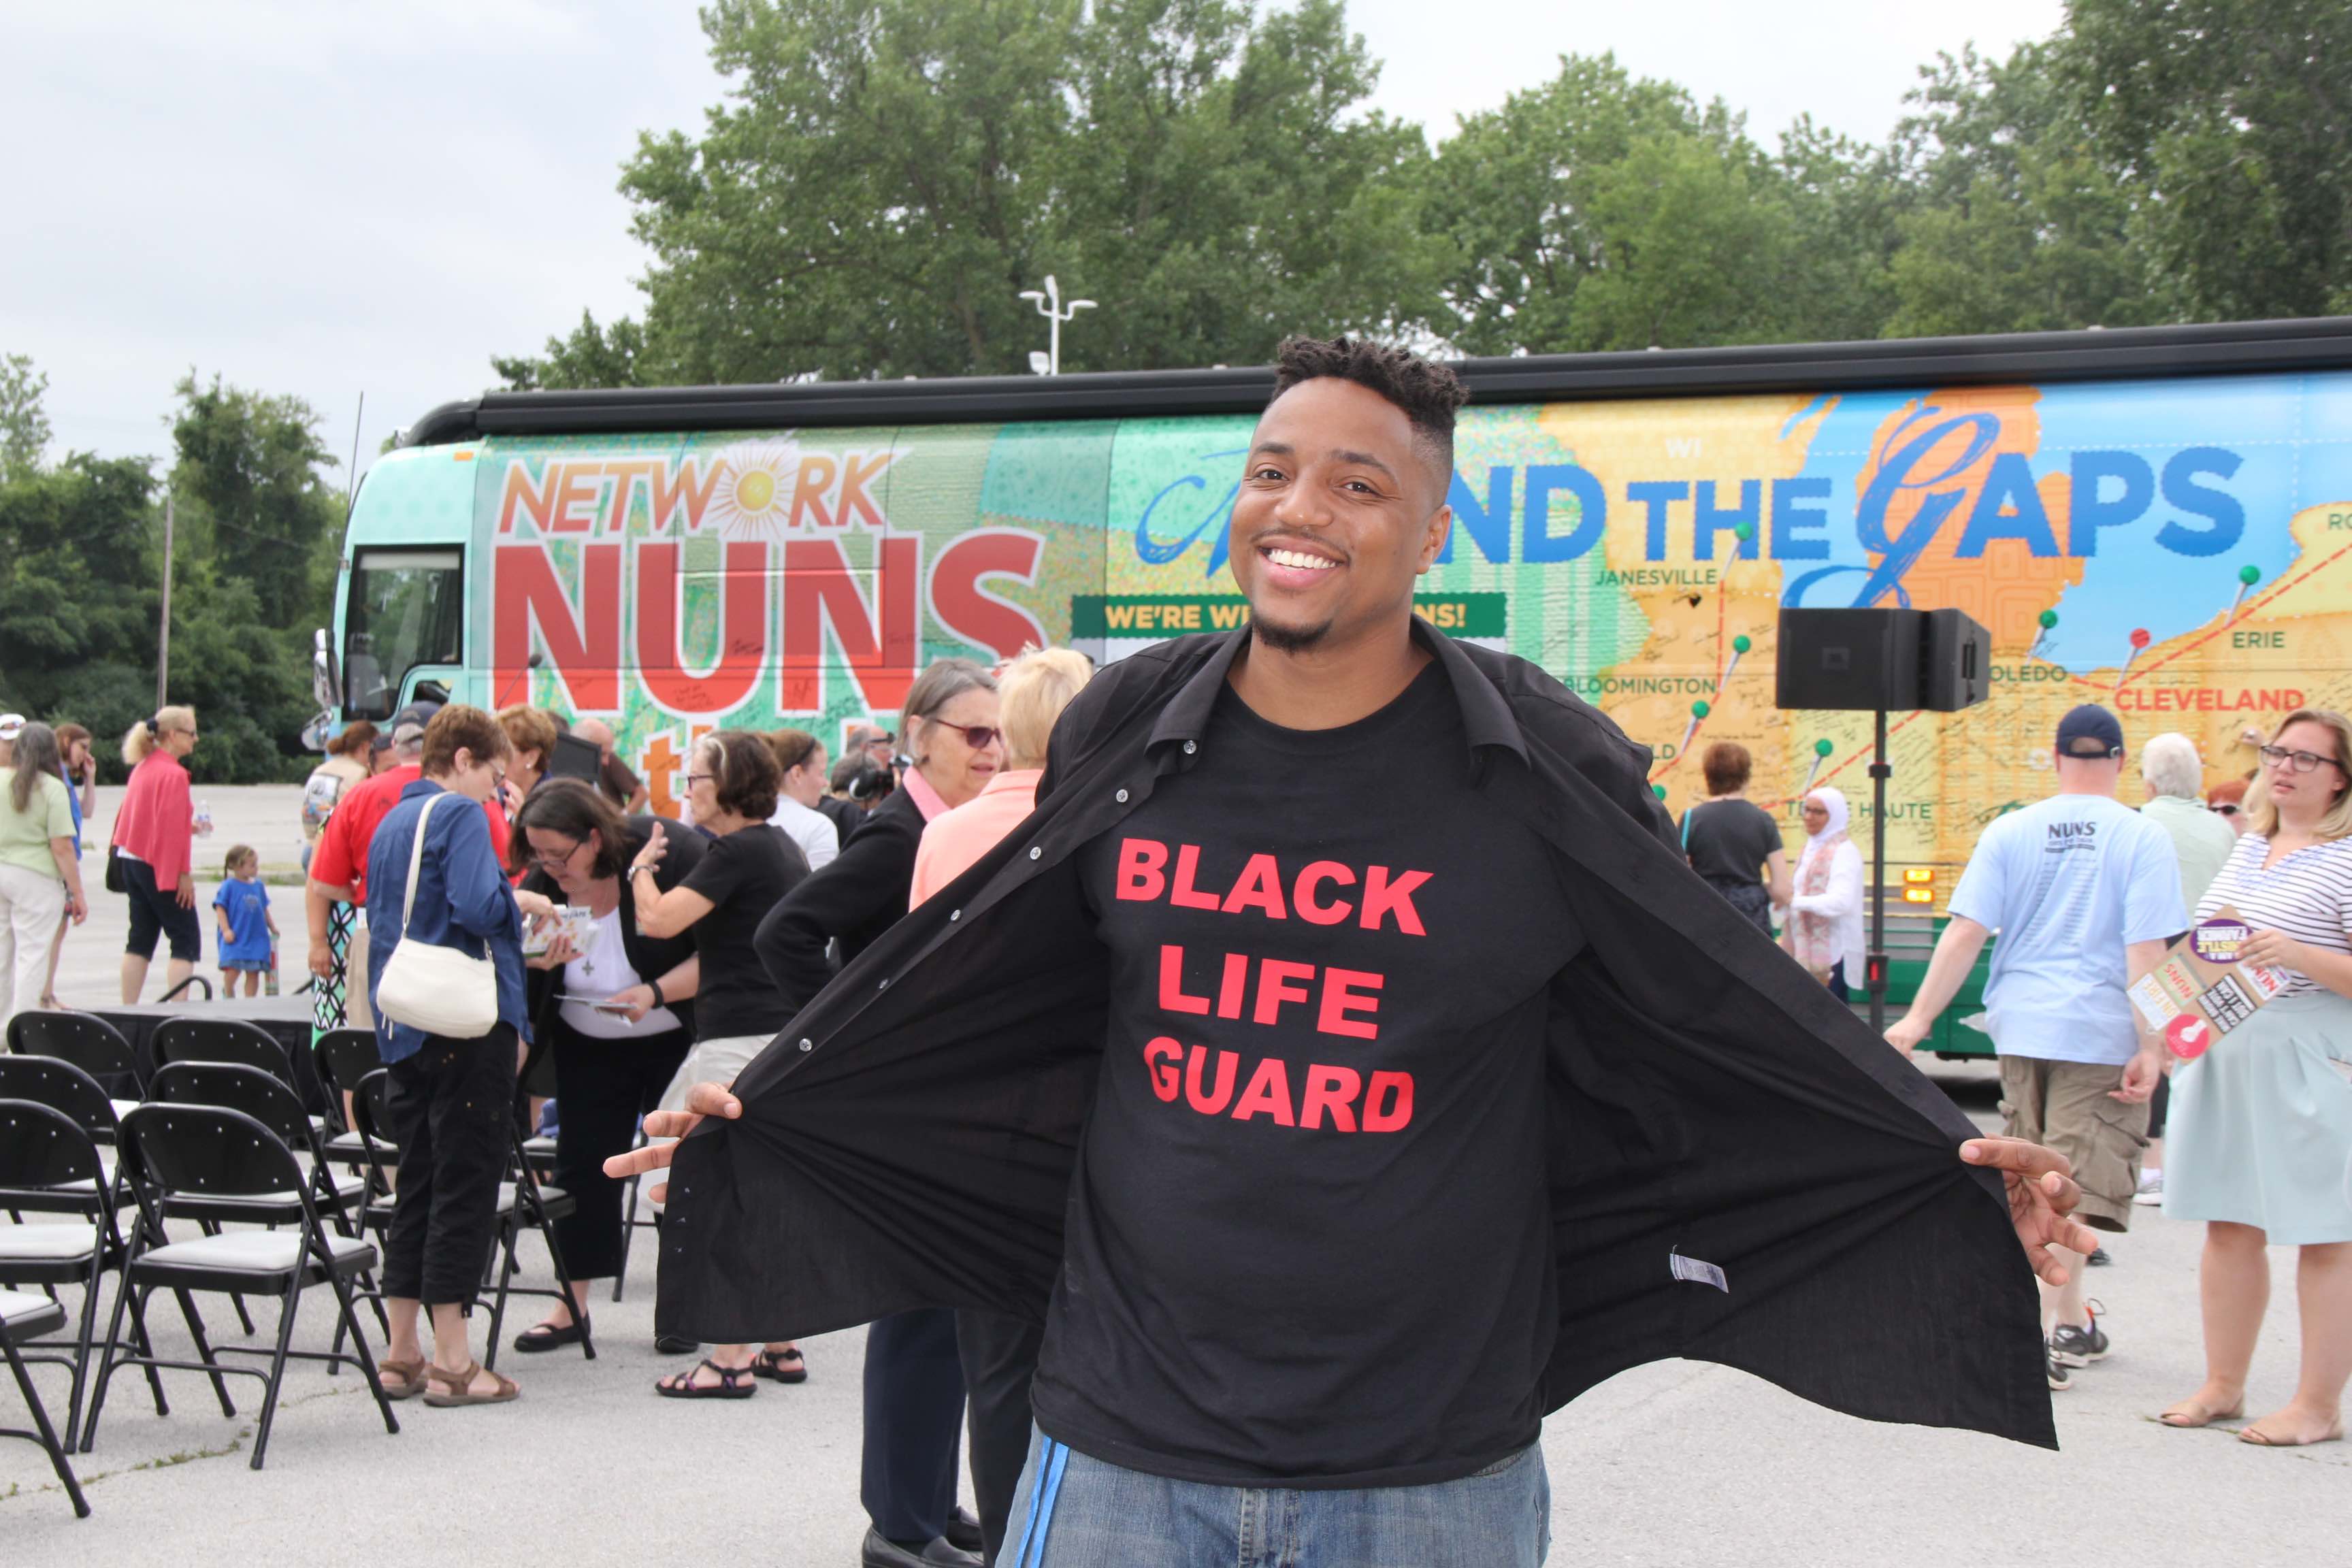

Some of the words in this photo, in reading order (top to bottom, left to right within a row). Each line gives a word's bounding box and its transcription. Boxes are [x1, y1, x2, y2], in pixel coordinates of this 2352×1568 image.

[1665, 438, 1701, 458] WI
[1626, 478, 1833, 561] THE
[1781, 406, 2246, 609] GAPS
[1595, 569, 1718, 586] JANESVILLE
[493, 534, 1046, 715] NUNS
[1105, 605, 1201, 629] WE'RE
[2232, 632, 2286, 649] ERIE
[1989, 666, 2068, 681] OLEDO
[1564, 678, 1717, 694] BLOOMINGTON
[2114, 688, 2306, 711] CLEVELAND
[2048, 821, 2097, 839] NUNS
[1116, 838, 1434, 936] BLACK
[1159, 945, 1384, 1039] LIFE
[1143, 1036, 1414, 1132] GUARD
